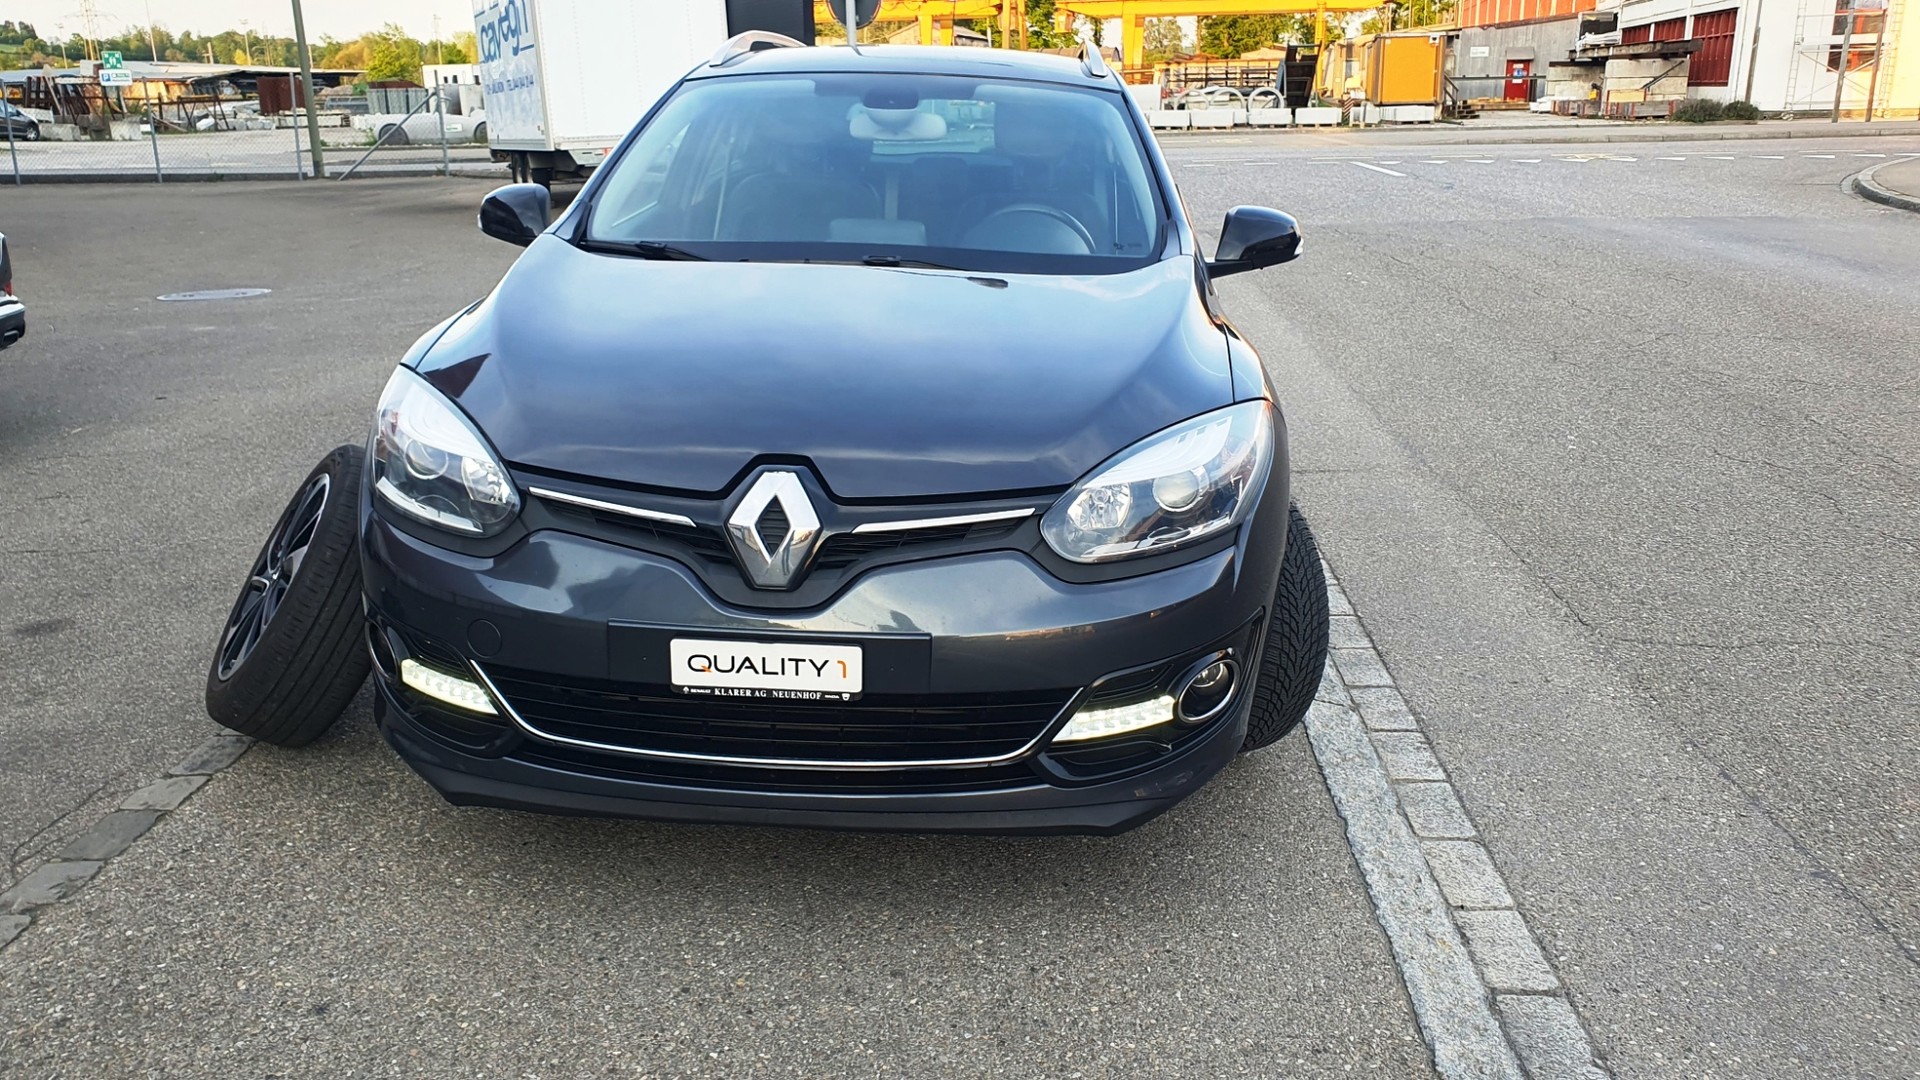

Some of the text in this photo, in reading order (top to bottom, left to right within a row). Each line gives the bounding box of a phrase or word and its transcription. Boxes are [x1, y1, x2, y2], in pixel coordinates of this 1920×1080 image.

[687, 654, 847, 678] QUALITY 1
[714, 687, 752, 697] KLARER
[753, 689, 767, 698] AG
[772, 690, 823, 700] NEUENHOF
